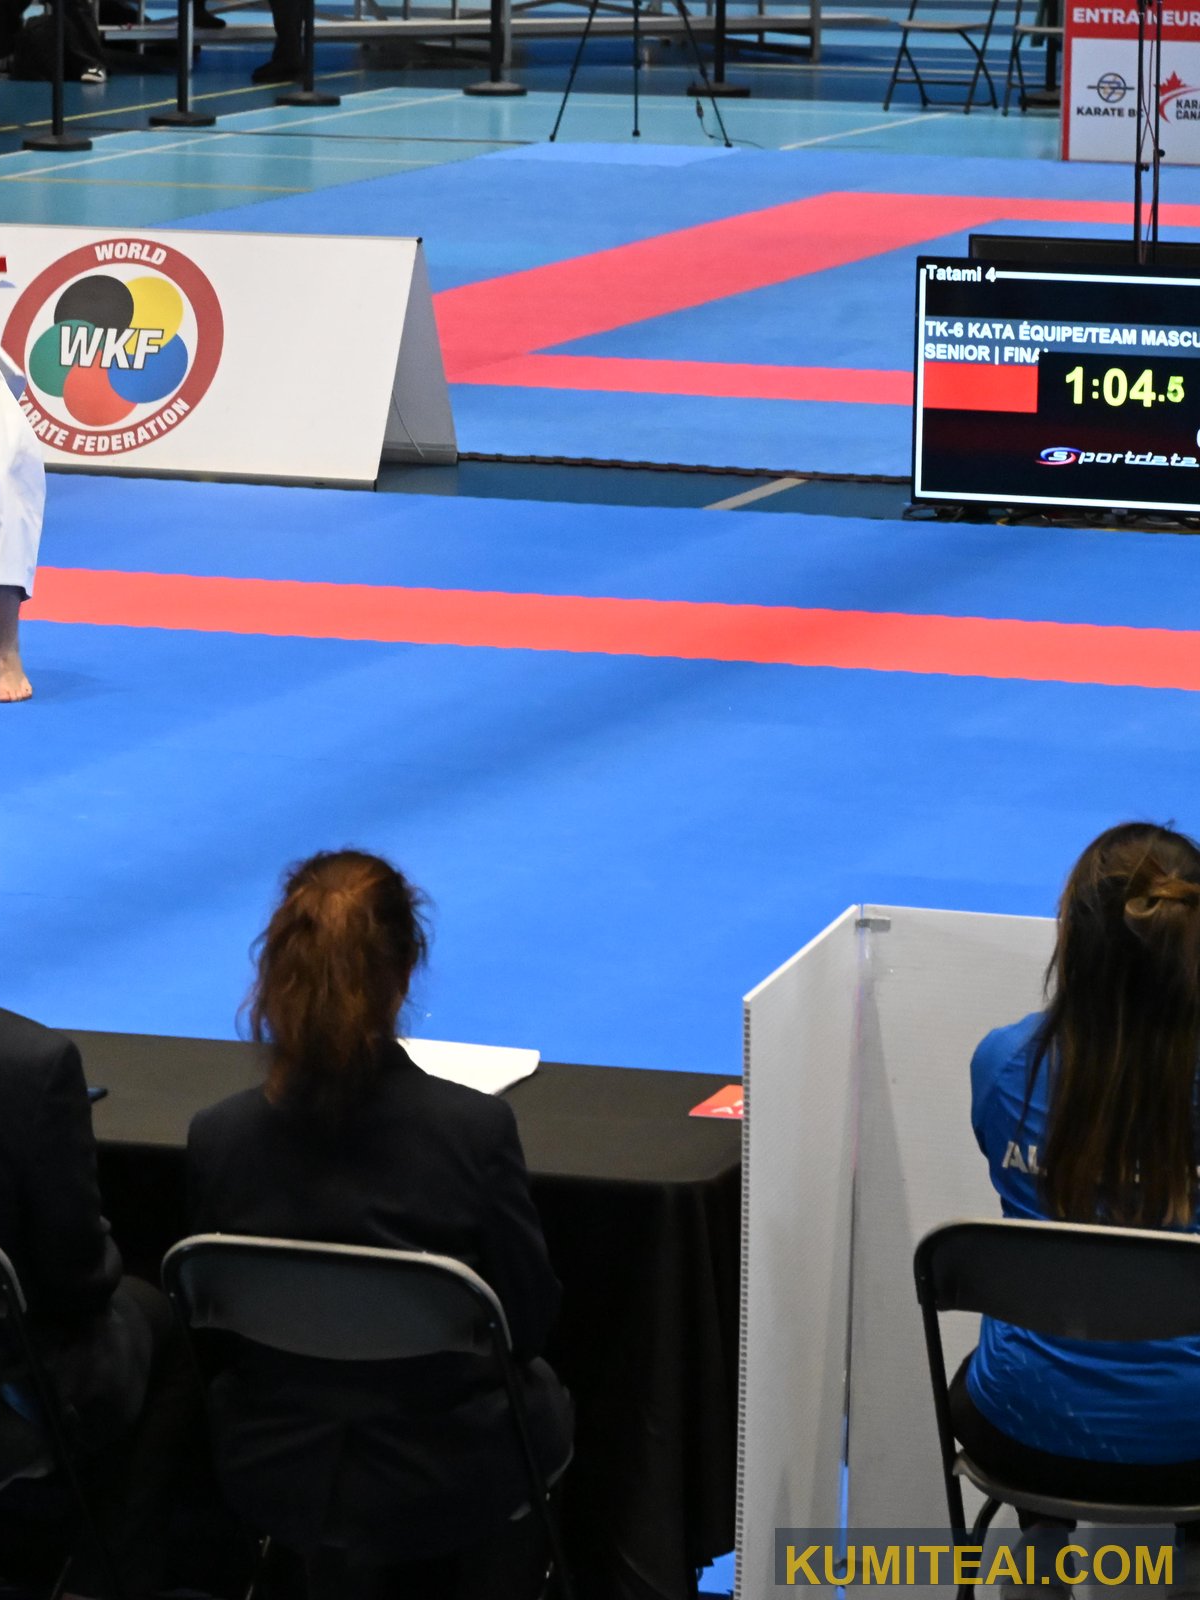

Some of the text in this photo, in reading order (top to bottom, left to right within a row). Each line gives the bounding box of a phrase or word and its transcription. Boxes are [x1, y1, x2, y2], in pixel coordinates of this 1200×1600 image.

[1073, 8, 1200, 27] ENTRANEUR
[1076, 107, 1125, 118] KARATE
[1176, 99, 1200, 110] KAR
[95, 242, 167, 265] WORLD
[926, 264, 996, 282] Tatami 4
[925, 321, 964, 337] TK-6
[968, 322, 1015, 340] KATA
[1019, 320, 1136, 345] ÉQUIPE/TEAM
[60, 325, 164, 370] WKF
[924, 343, 990, 361] SENIOR
[1004, 347, 1049, 363] FINA
[1065, 366, 1184, 407] 1:04.5
[72, 397, 191, 453] FEDERATION
